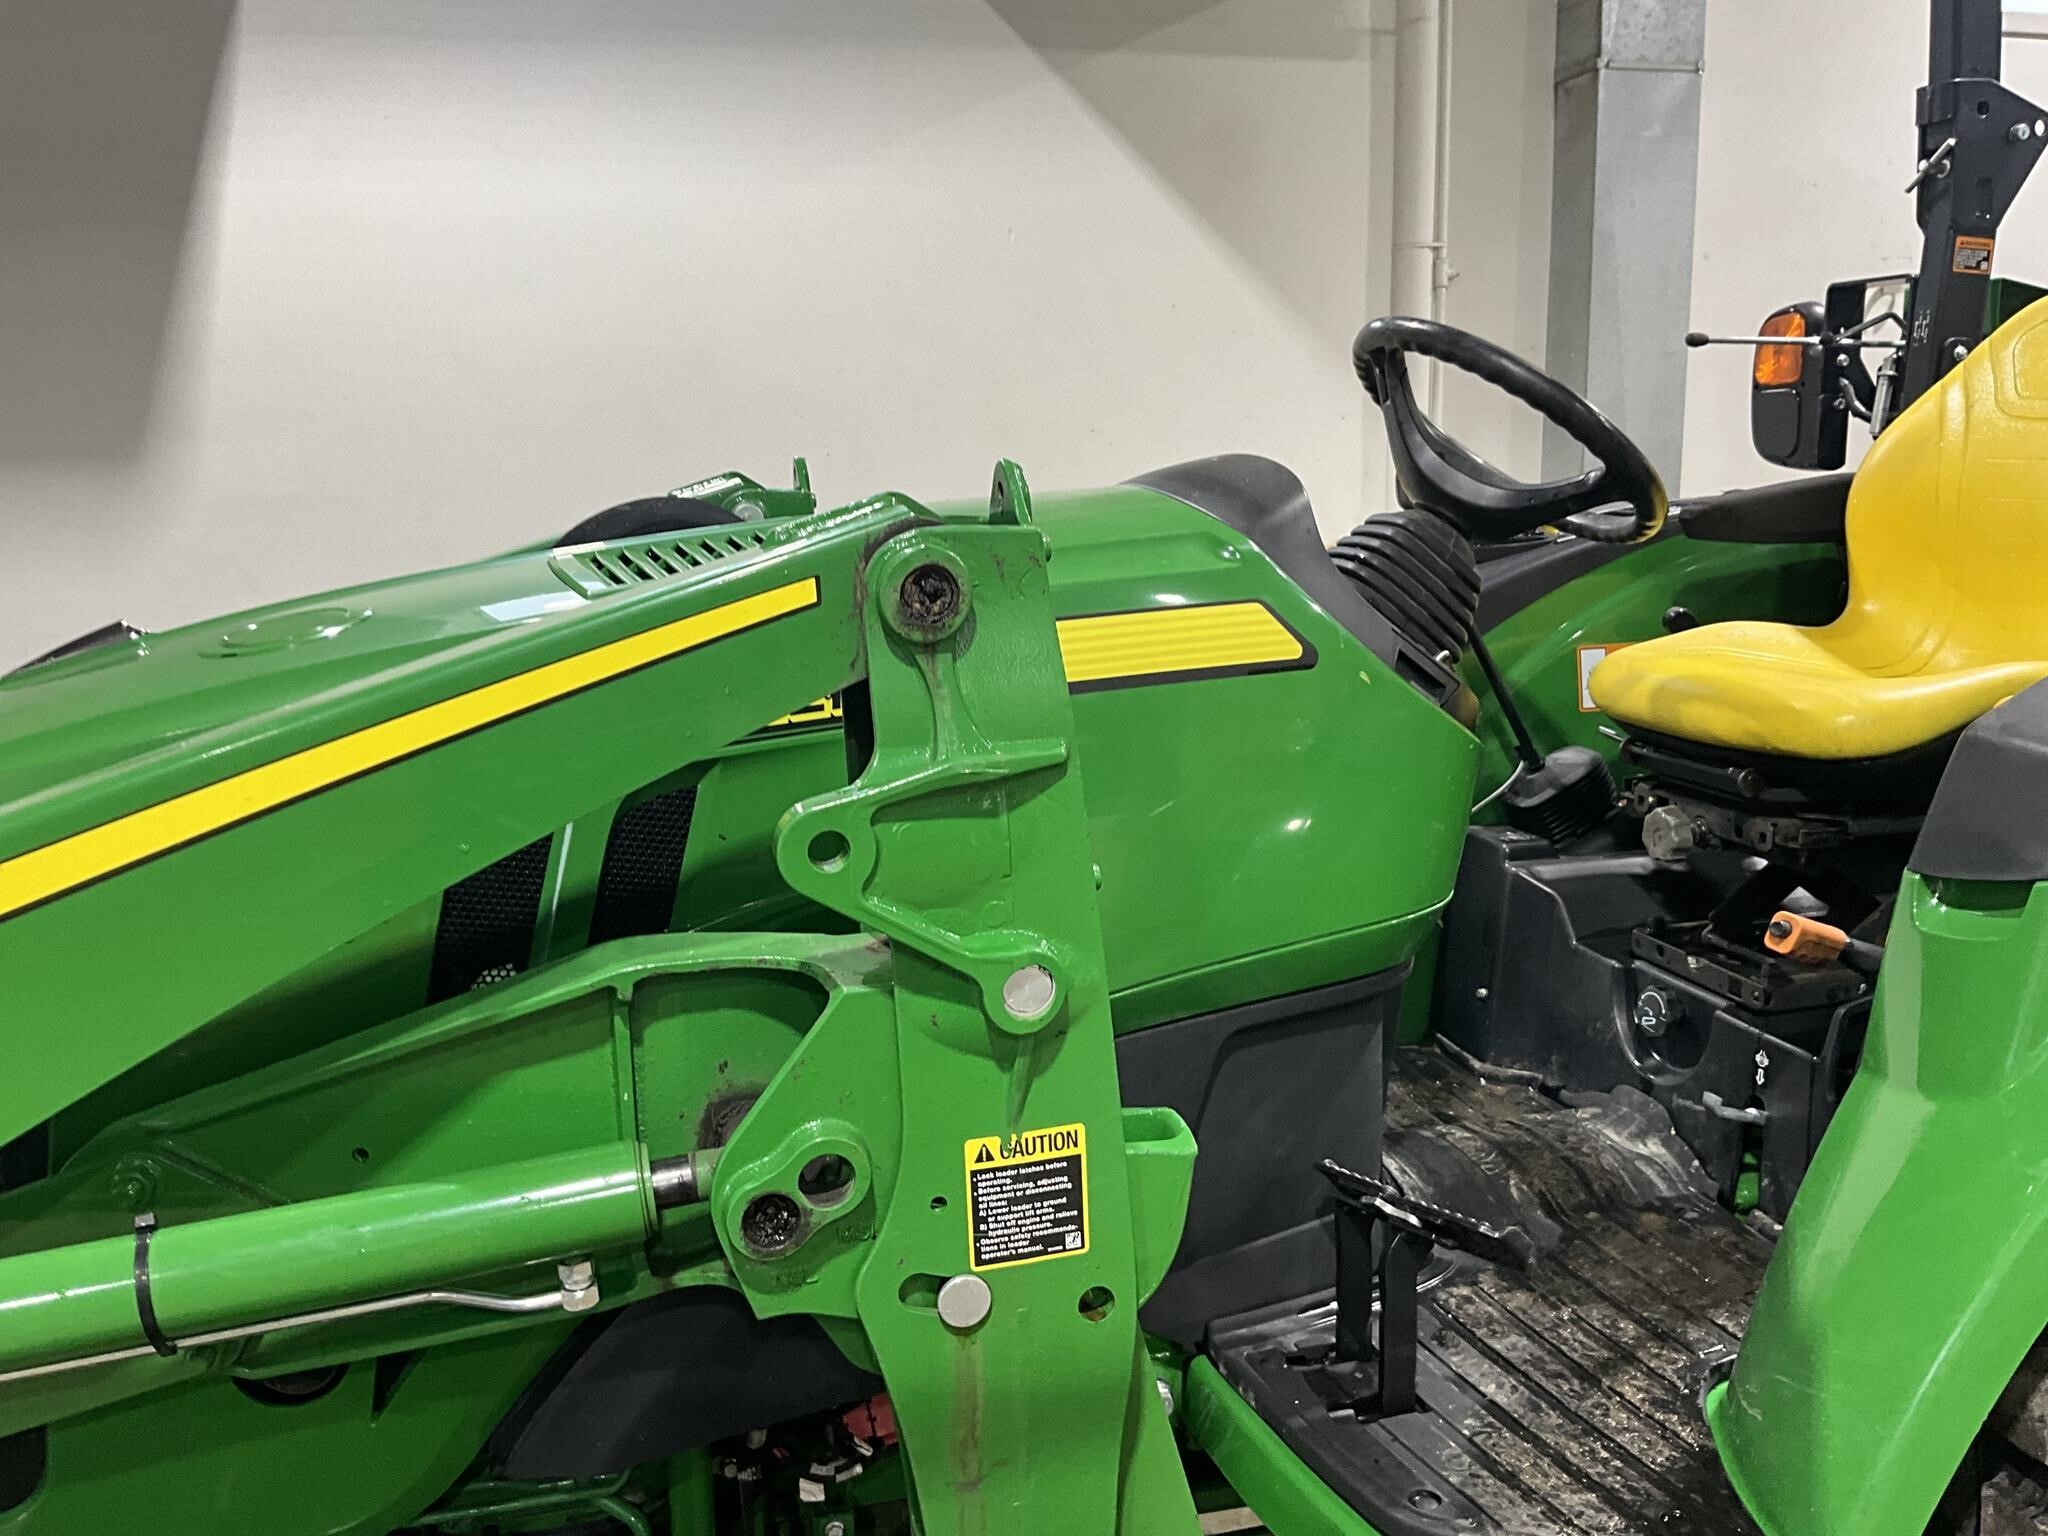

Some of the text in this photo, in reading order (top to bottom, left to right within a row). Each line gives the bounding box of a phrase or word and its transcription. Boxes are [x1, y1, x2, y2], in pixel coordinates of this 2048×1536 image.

[1000, 1130, 1078, 1159] CAUTION
[996, 1169, 1017, 1177] loader
[1019, 1165, 1044, 1174] latches
[978, 1178, 1012, 1187] operating.
[978, 1187, 1001, 1195] Before
[1037, 1176, 1068, 1186] adjusting
[978, 1191, 1014, 1201] equipment
[1025, 1182, 1072, 1195] disconnecting
[988, 1207, 1009, 1215] Lower
[1043, 1197, 1066, 1207] ground
[997, 1212, 1023, 1221] support
[1036, 1207, 1054, 1215] arms.
[1018, 1216, 1040, 1225] engine
[1056, 1210, 1078, 1218] relieve
[988, 1222, 1052, 1237] hydraulic pressure.
[981, 1237, 1009, 1245] Observe
[1010, 1232, 1031, 1240] safety
[1008, 1240, 1029, 1248] loader
[1018, 1244, 1044, 1253] manual.
